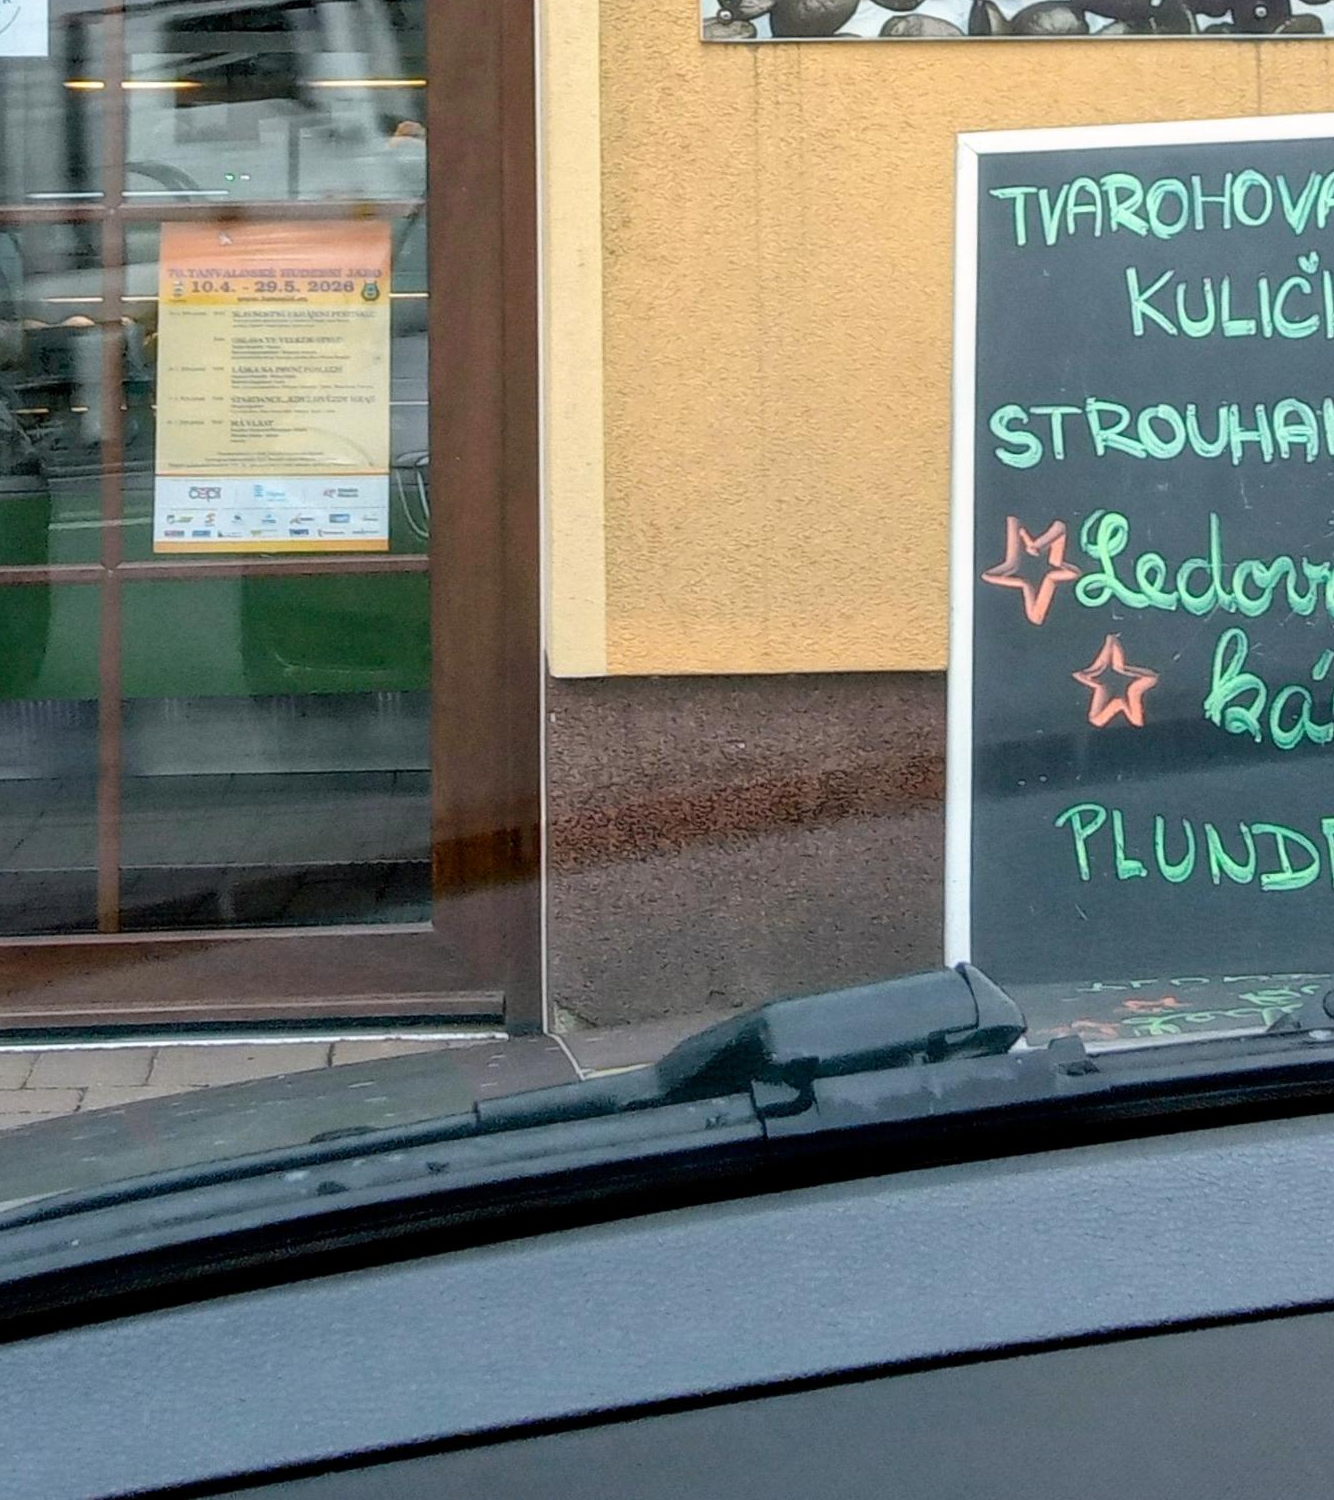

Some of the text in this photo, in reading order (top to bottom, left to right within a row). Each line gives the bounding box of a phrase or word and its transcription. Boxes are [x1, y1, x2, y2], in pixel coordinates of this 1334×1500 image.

[191, 280, 236, 293] 10.4.
[254, 280, 301, 293] 29.5.
[307, 280, 355, 293] 2026
